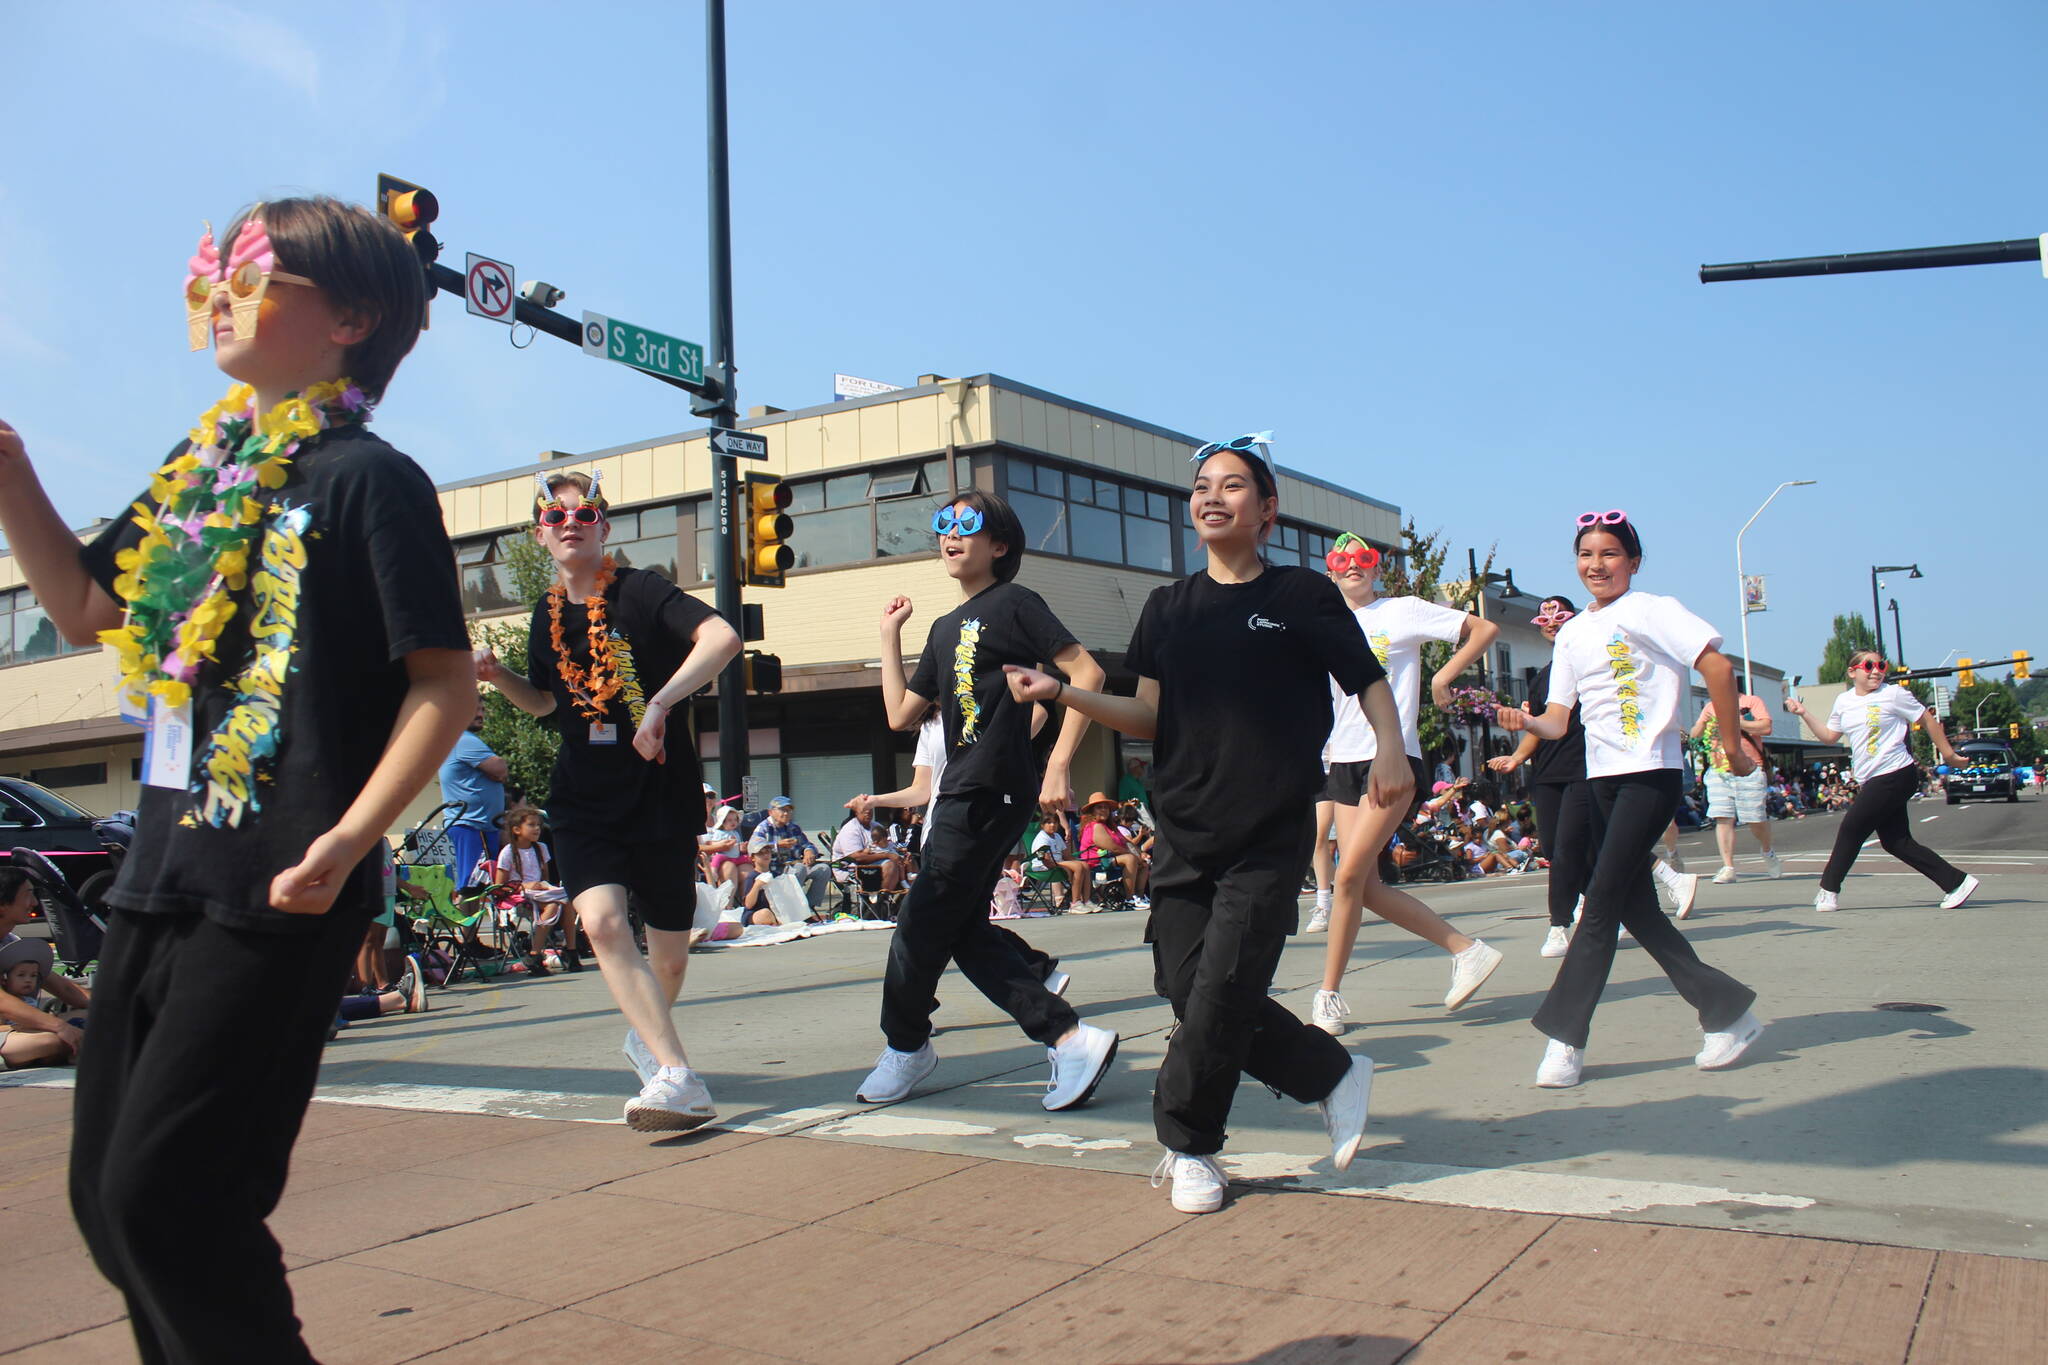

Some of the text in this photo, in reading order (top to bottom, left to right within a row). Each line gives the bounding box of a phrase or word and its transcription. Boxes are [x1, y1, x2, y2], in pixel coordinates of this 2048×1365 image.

[612, 326, 699, 378] S 3rd St
[727, 437, 762, 452] ONE WAY
[204, 528, 308, 829] BODY LANGUAGE
